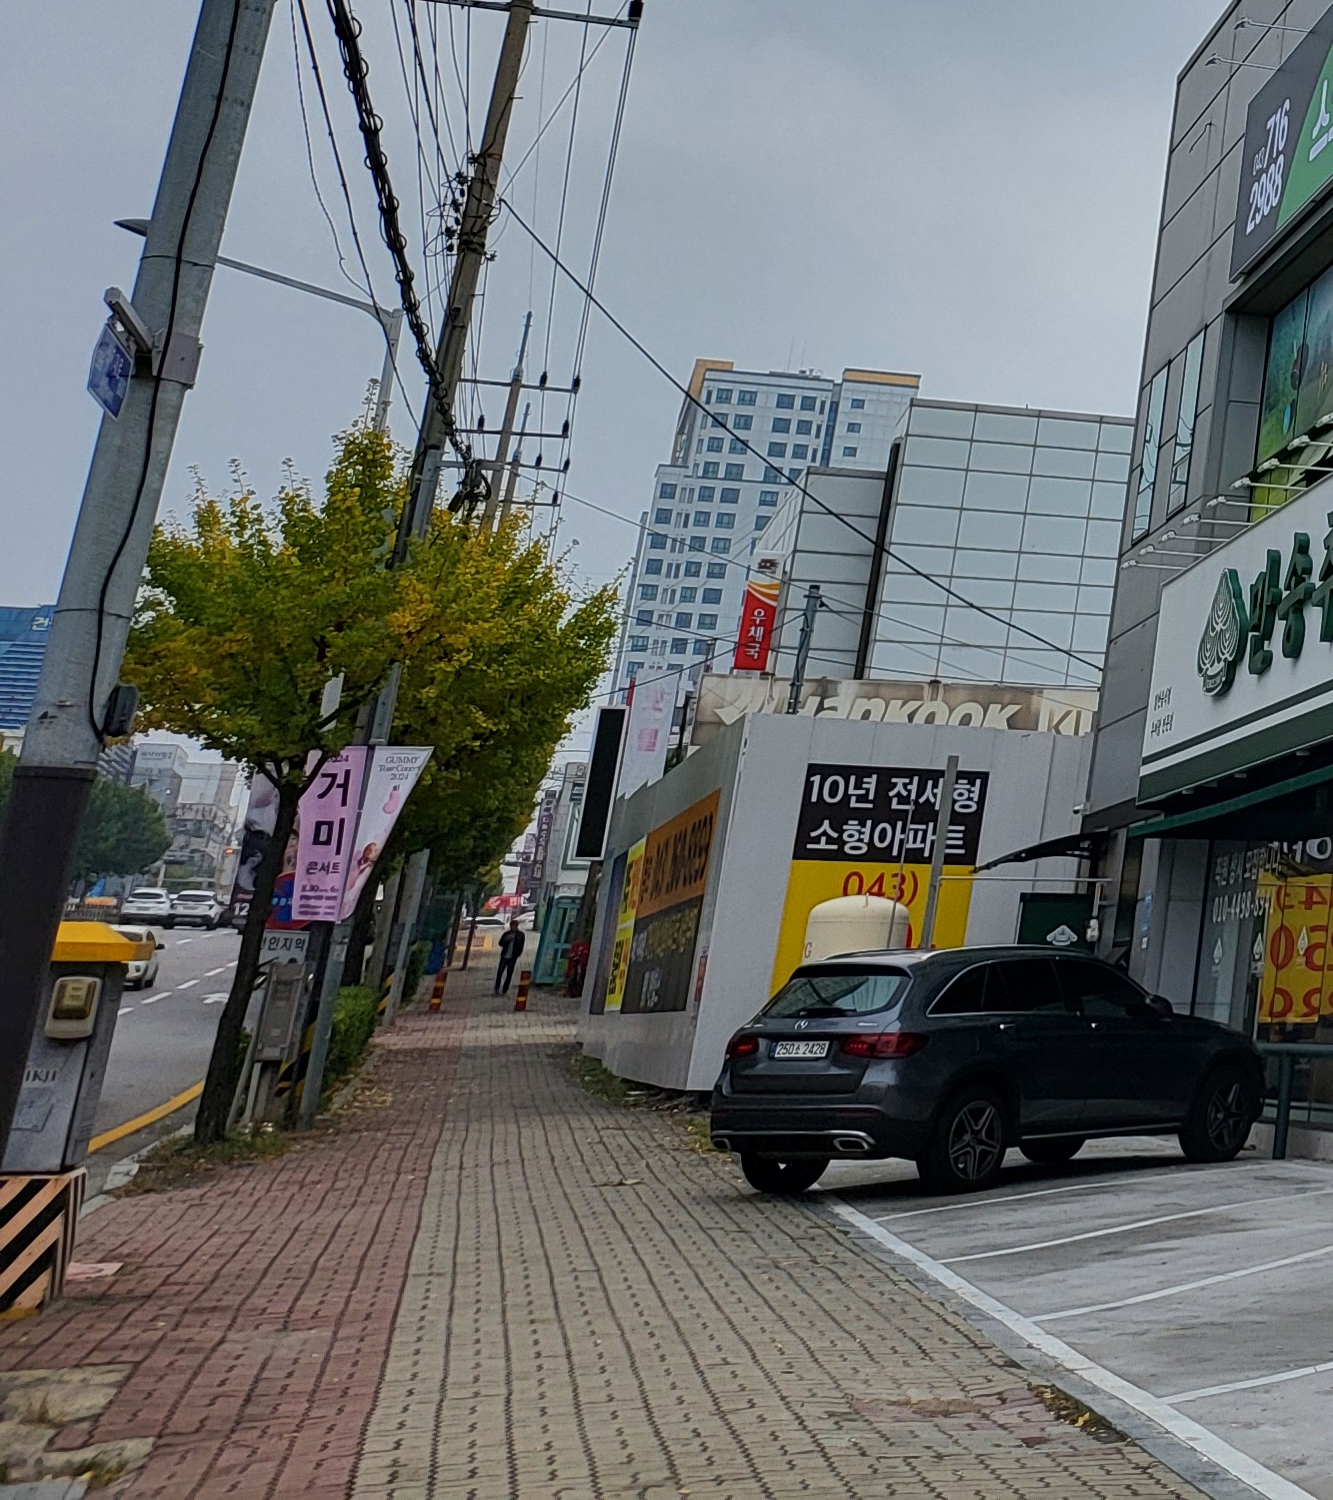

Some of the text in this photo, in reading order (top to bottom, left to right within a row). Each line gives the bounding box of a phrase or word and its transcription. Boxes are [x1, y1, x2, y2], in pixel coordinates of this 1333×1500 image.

[1264, 98, 1291, 170] 716
[1245, 153, 1285, 237] 2988
[747, 608, 765, 660] 우체국
[312, 768, 352, 856] 거미
[808, 773, 878, 810] 10년
[805, 818, 967, 857] 소형아파트
[306, 861, 341, 875] 콘서트
[802, 1042, 827, 1056] 2428
